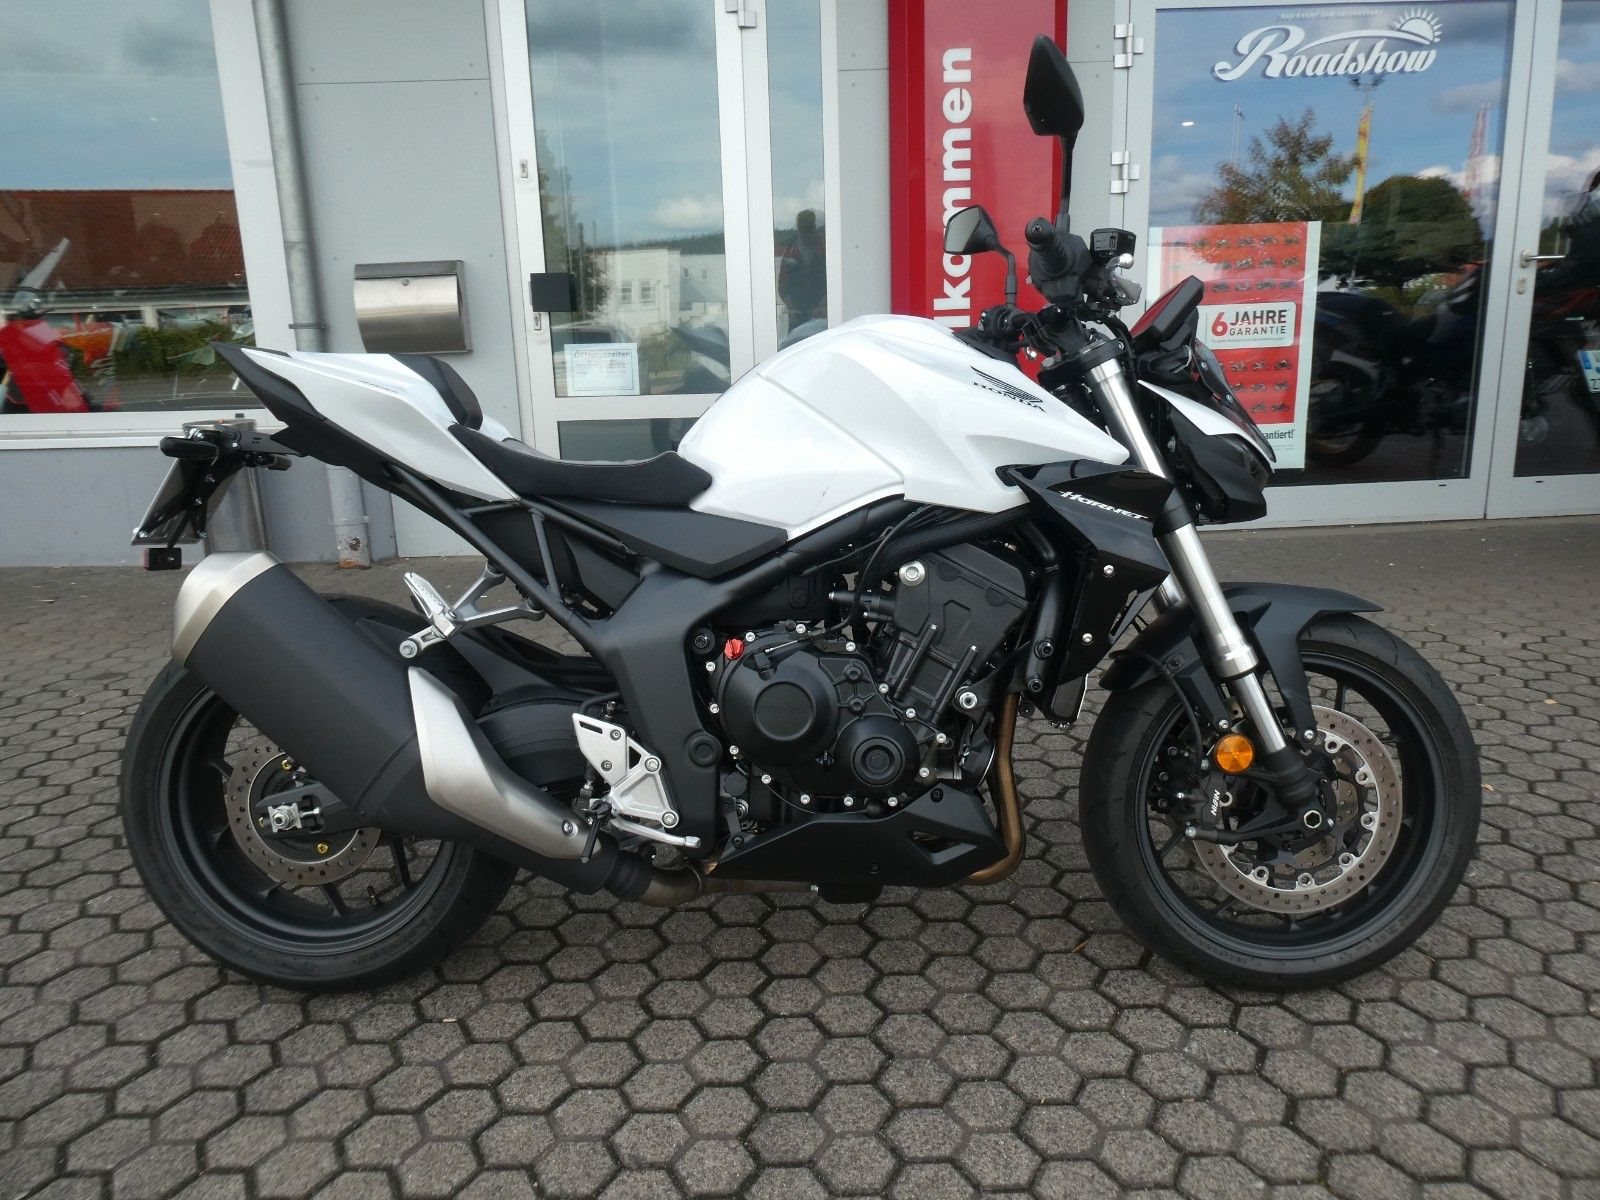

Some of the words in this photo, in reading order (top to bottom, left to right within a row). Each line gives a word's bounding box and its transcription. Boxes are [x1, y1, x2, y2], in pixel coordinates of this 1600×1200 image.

[1214, 24, 1437, 81] Roadshow
[1211, 312, 1228, 337] 6
[1230, 309, 1287, 326] JAHRE
[1229, 326, 1286, 336] GARANTIE
